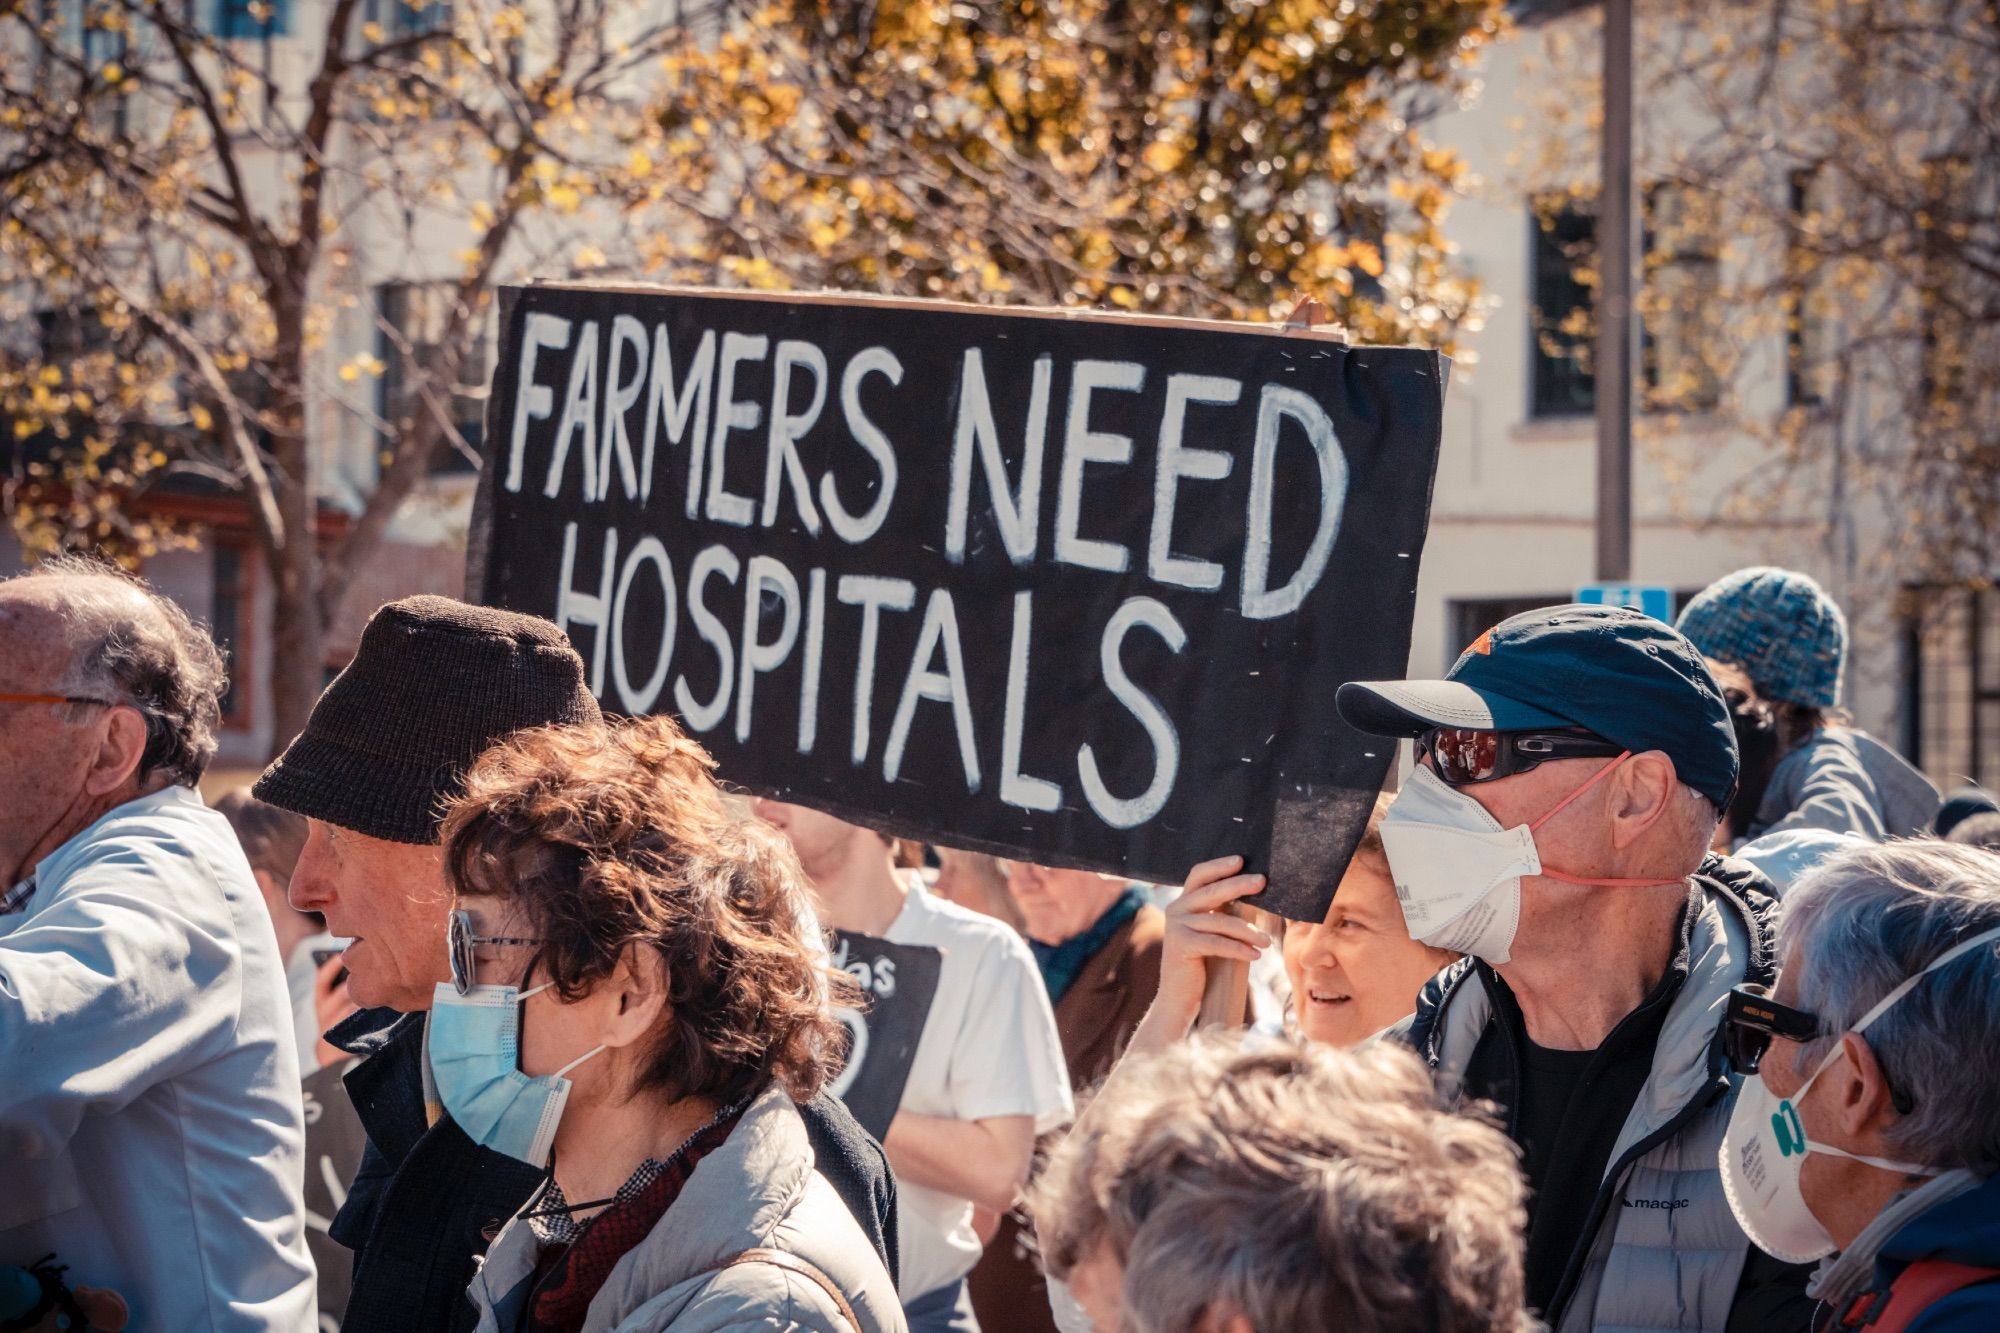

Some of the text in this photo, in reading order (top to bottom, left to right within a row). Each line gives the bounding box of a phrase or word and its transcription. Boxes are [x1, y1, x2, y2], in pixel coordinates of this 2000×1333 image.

[505, 312, 1348, 620] FARMERS NEED
[557, 522, 1187, 829] HOSPITALS
